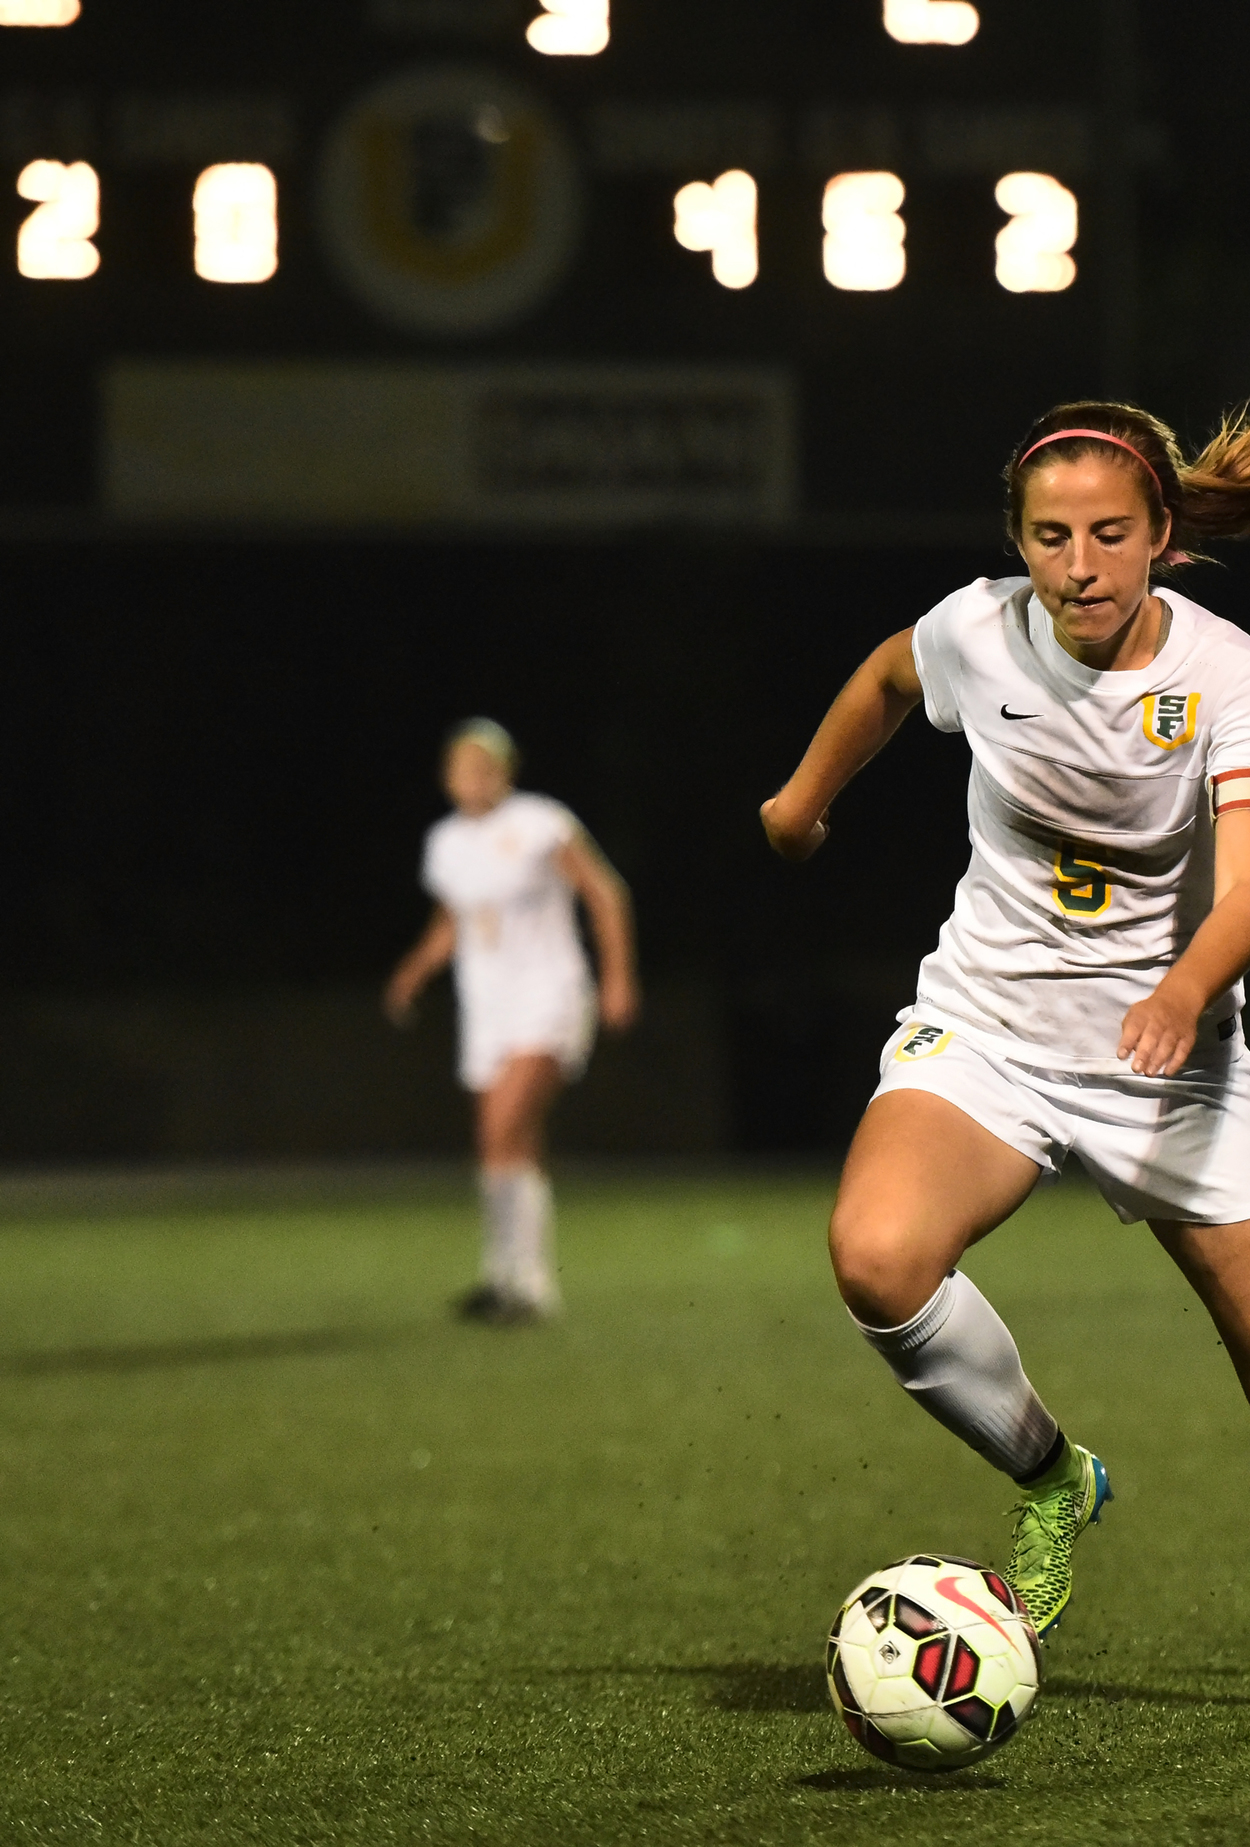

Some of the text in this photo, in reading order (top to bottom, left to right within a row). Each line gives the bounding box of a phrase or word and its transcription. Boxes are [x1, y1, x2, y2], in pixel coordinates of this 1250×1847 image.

[18, 160, 99, 279] 2
[995, 173, 1077, 292] 2
[1052, 838, 1112, 918] 5
